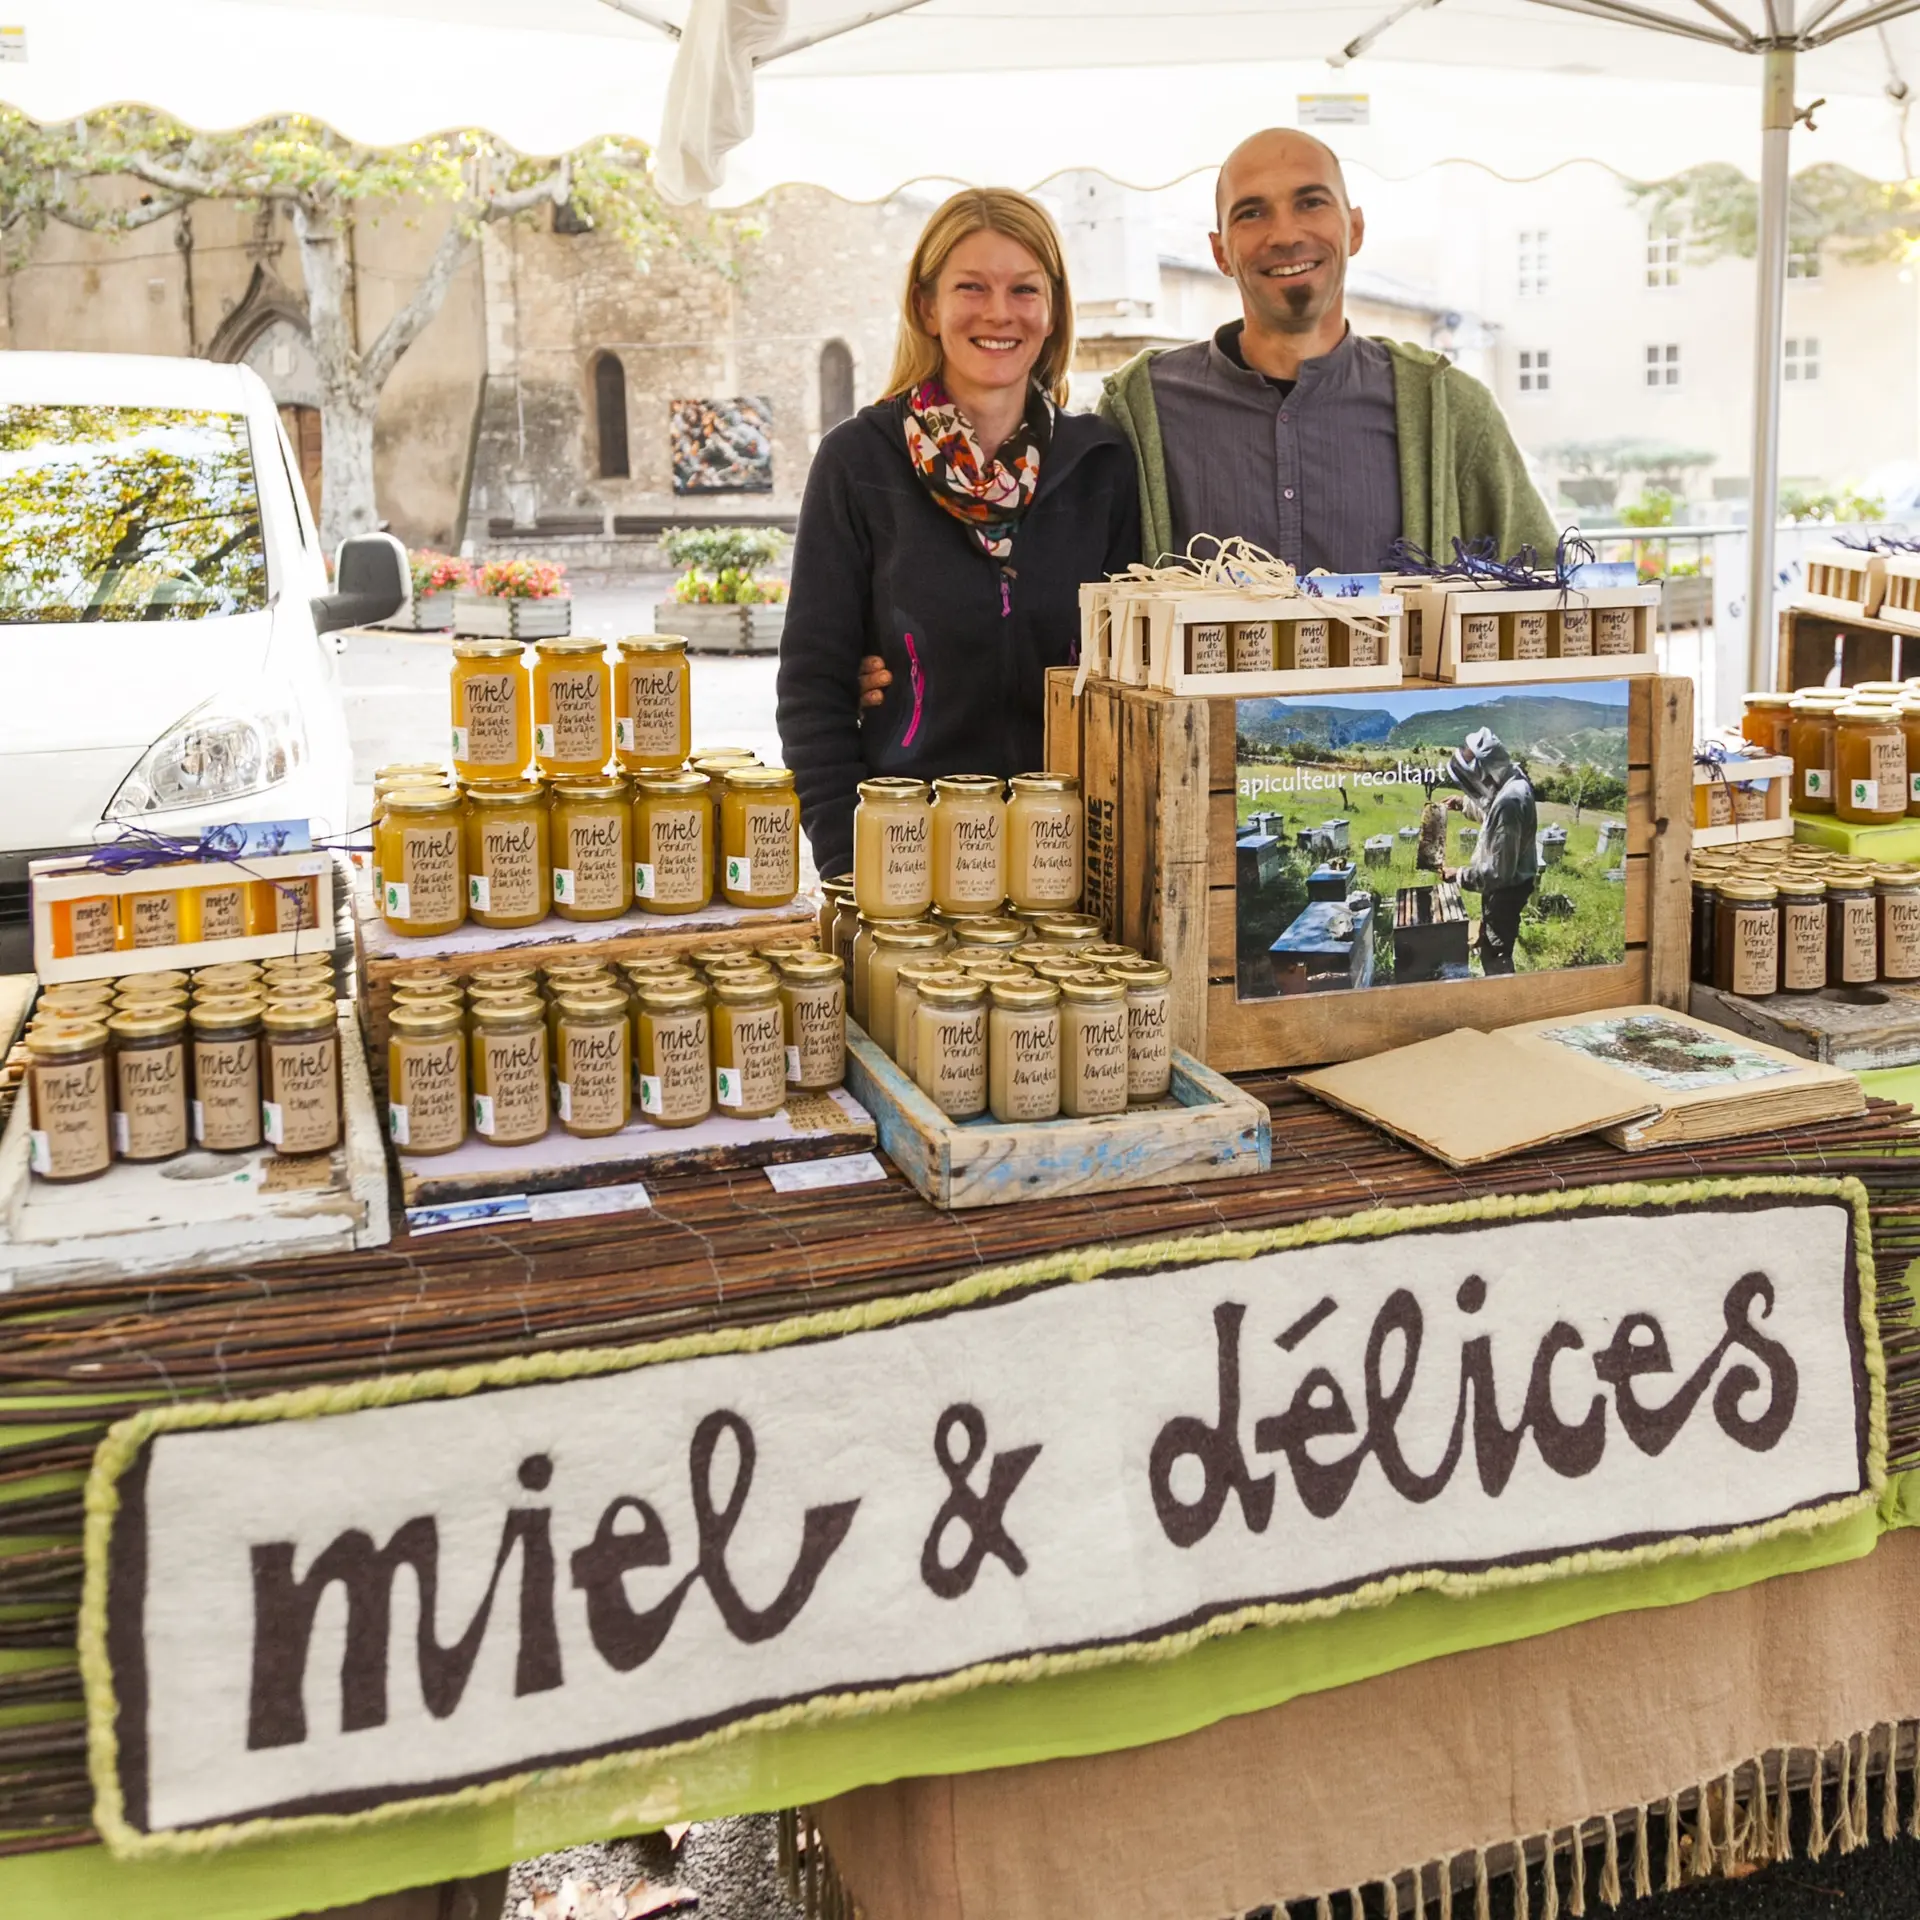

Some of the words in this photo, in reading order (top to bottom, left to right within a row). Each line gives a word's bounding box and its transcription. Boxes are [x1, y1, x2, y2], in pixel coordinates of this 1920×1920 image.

[1302, 624, 1326, 636] miel
[1468, 621, 1494, 632] miel
[1521, 617, 1544, 628] miel
[1602, 612, 1629, 624] miel
[1198, 630, 1224, 642] miel
[1239, 628, 1266, 640] miel
[464, 677, 515, 702] miel
[550, 675, 599, 700] miel
[630, 670, 680, 695] miel
[1240, 766, 1345, 800] apiculteur
[571, 821, 620, 846] miel
[652, 815, 701, 840] miel
[748, 808, 794, 834] miel
[886, 817, 928, 842] miel
[954, 816, 998, 842] miel
[1032, 814, 1075, 840] miel
[406, 832, 456, 858] miel
[485, 827, 536, 852] miel
[76, 902, 108, 920] miel
[136, 899, 169, 914] miel
[206, 893, 238, 908] miel
[1888, 901, 1920, 920] mie
[1738, 912, 1775, 935] miel
[1789, 907, 1825, 930] miel
[1848, 904, 1874, 924] mie
[795, 992, 844, 1020] miel
[1128, 1000, 1168, 1028] miel
[656, 1020, 707, 1050] miel
[734, 1012, 783, 1043] miel
[938, 1016, 985, 1045] miel
[1010, 1020, 1057, 1049] miel
[1080, 1015, 1125, 1044] miel
[489, 1037, 544, 1067] miel
[568, 1031, 623, 1059] miel
[123, 1051, 180, 1083] miel
[198, 1045, 254, 1075] miel
[276, 1045, 332, 1077] miel
[404, 1047, 459, 1077] miel
[44, 1067, 103, 1098] miel
[246, 1408, 862, 1751] miel
[920, 1401, 1043, 1598] &
[1150, 1270, 1800, 1548] délices
